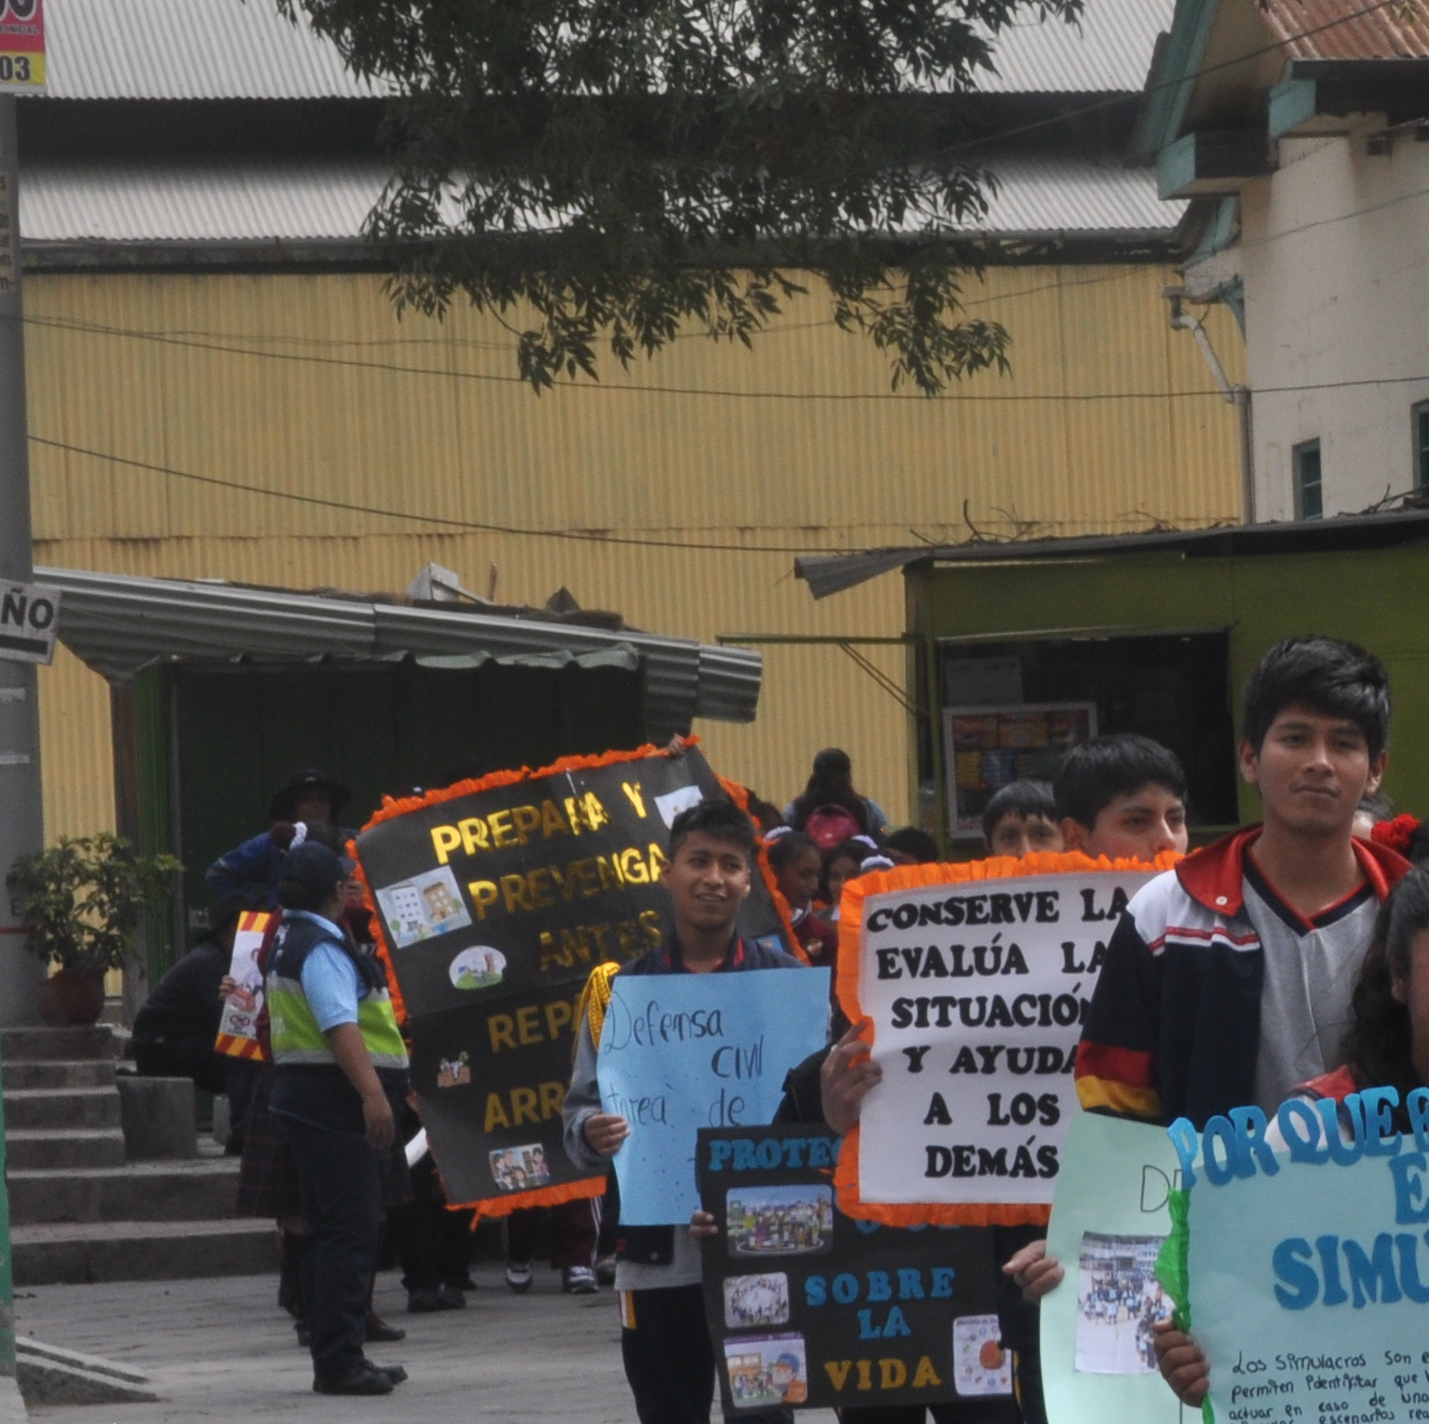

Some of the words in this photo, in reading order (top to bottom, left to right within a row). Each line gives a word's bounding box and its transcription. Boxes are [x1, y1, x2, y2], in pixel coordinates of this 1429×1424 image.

[0, 586, 54, 630] ÑO
[430, 791, 609, 865] PREPARA
[622, 782, 648, 818] Y
[866, 890, 1060, 932] CONSERVE
[1080, 886, 1129, 922] LA
[538, 910, 664, 972] ANTES
[876, 932, 1029, 980] EVALÚA
[602, 990, 724, 1056] Defensa
[902, 1045, 932, 1074] Y
[924, 1092, 953, 1126] A
[987, 1092, 1061, 1126] LOS
[925, 1135, 1060, 1178] DEMÁS
[804, 1266, 955, 1307] SOBRE
[857, 1305, 912, 1339] LA
[824, 1355, 942, 1392] VIDA
[1232, 1350, 1267, 1374] Los
[1394, 1374, 1418, 1391] que
[1228, 1406, 1274, 1421] actuar
[1284, 1404, 1303, 1417] en
[1318, 1400, 1349, 1413] caso
[1368, 1390, 1386, 1407] de
